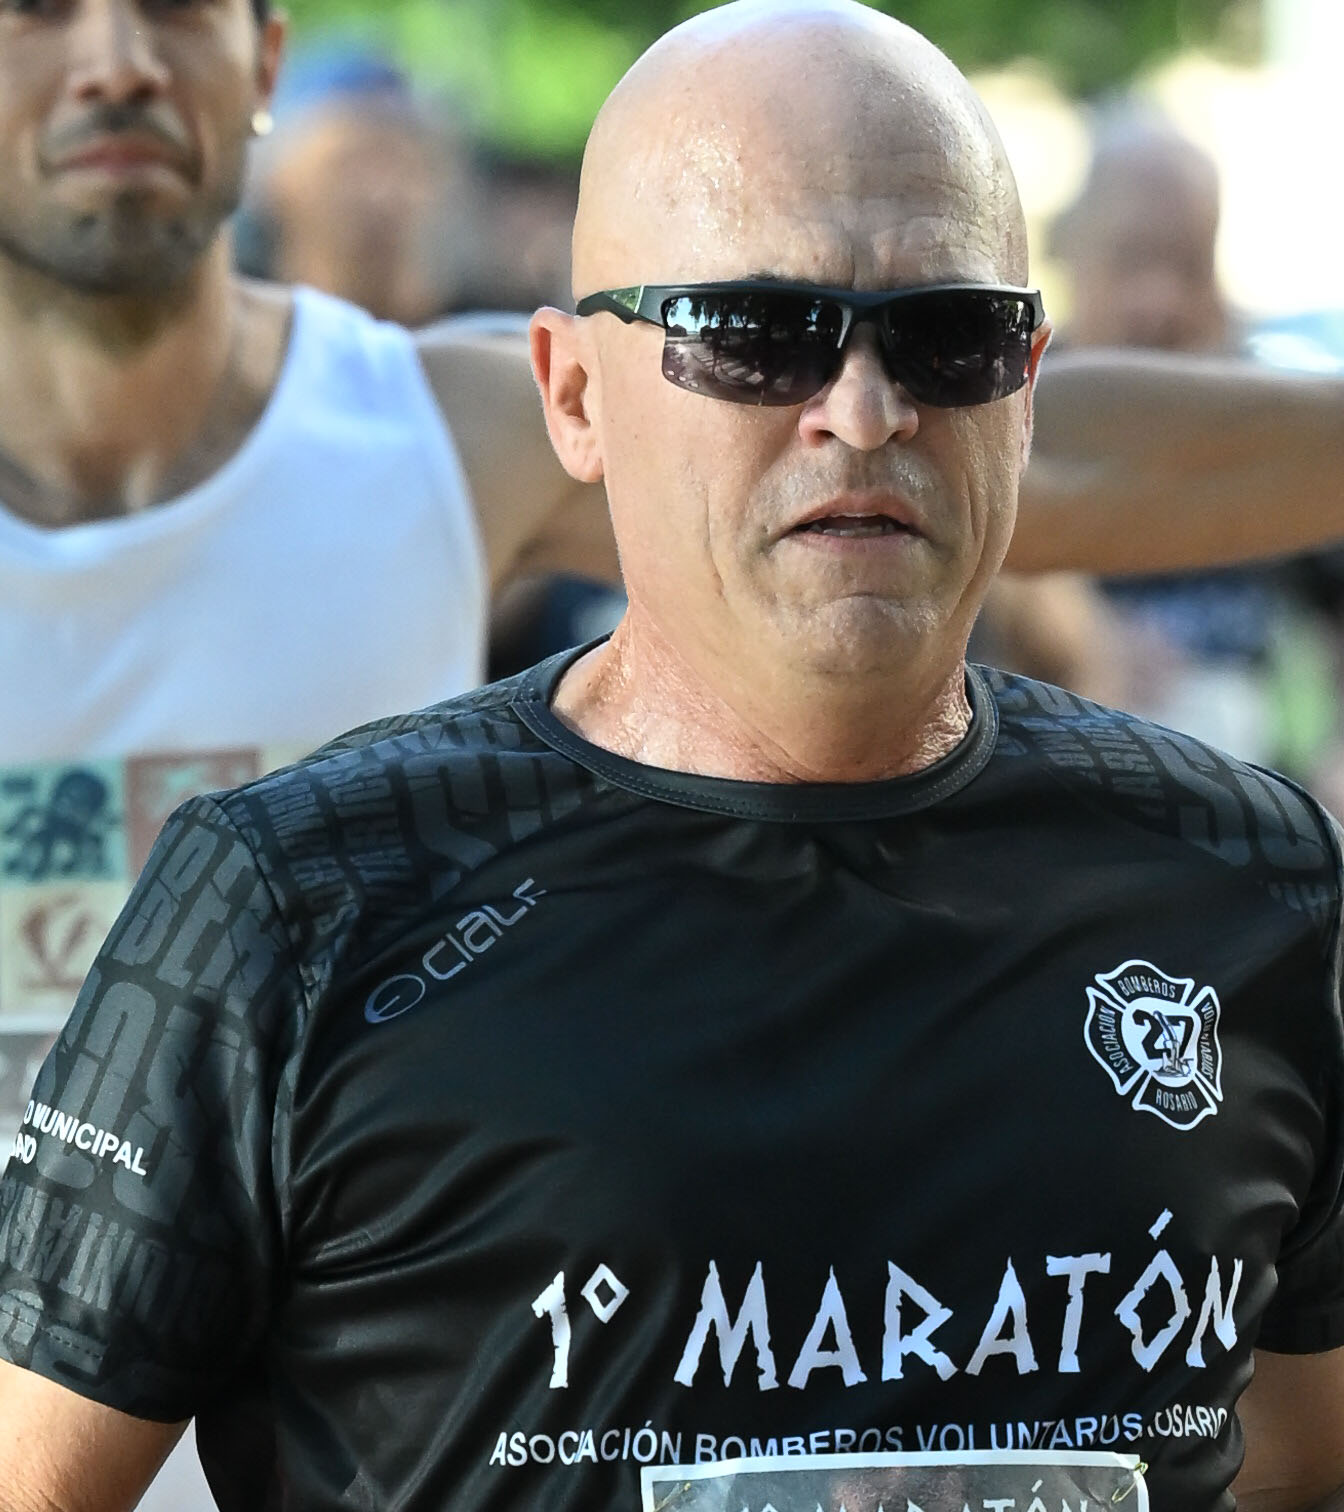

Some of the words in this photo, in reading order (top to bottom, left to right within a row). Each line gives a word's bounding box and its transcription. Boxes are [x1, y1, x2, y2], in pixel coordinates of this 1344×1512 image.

[1117, 975, 1176, 999] BOMBEROS
[1132, 1008, 1195, 1061] 27
[1156, 1089, 1198, 1112] ROSARIO
[32, 1101, 147, 1177] MUNICIPAL
[531, 1262, 630, 1389] 1°
[672, 1207, 1244, 1392] MARATÓN
[695, 1424, 904, 1466] BOMBEROS
